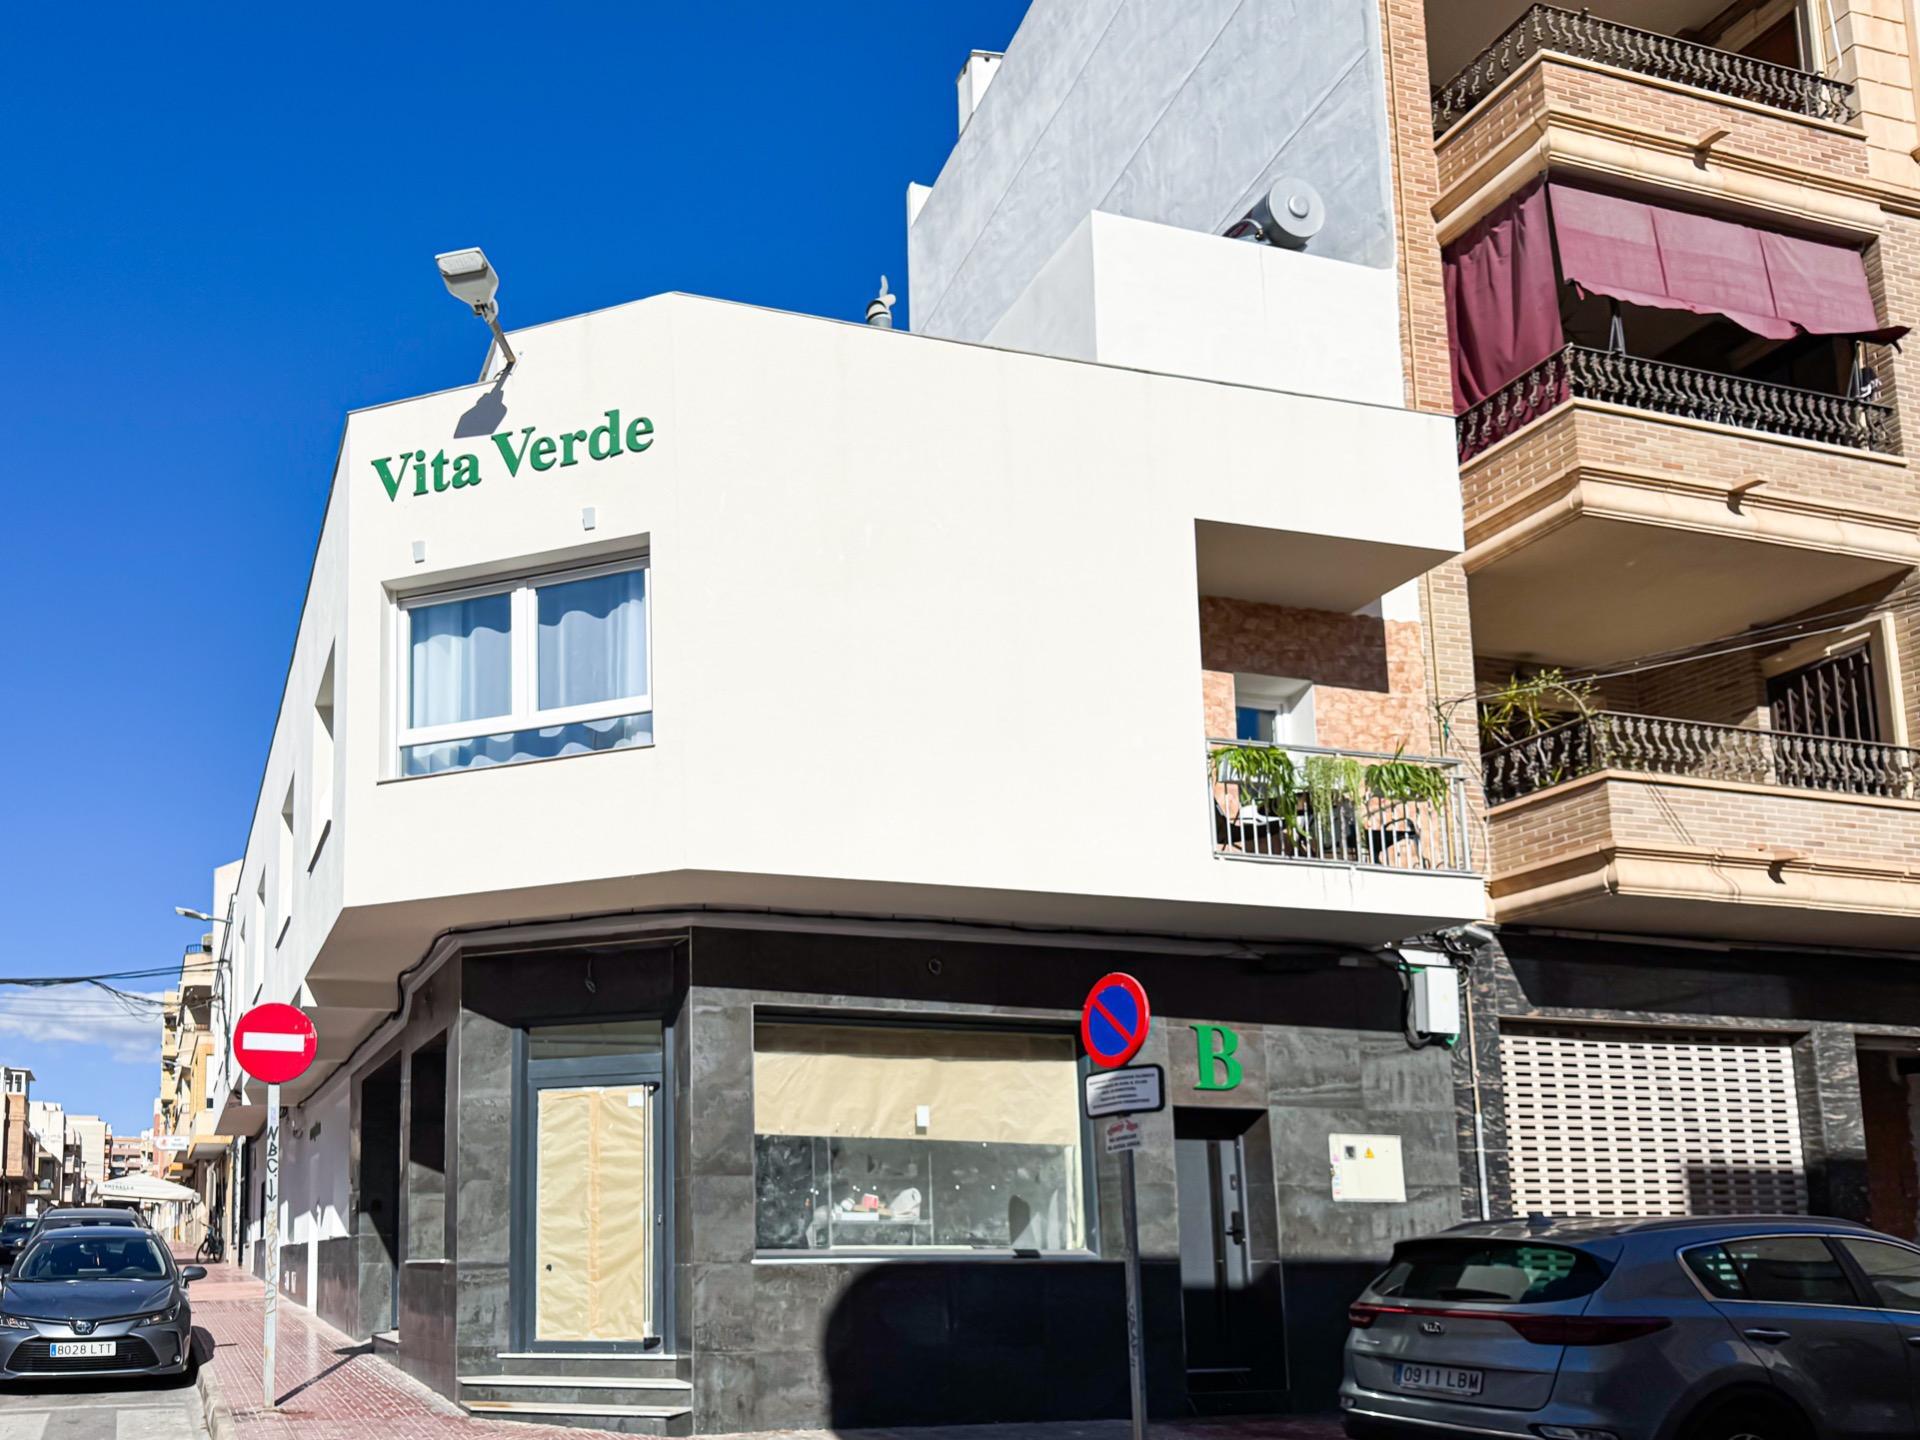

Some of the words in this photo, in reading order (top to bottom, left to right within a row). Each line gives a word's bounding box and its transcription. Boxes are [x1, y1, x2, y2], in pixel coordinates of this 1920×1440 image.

[371, 449, 482, 502] Vita
[491, 409, 655, 478] Verde
[1189, 1023, 1243, 1091] B
[57, 1344, 87, 1355] 8028
[90, 1343, 112, 1354] LTT
[1403, 1366, 1440, 1386] 0911
[1446, 1370, 1480, 1390] LBM
